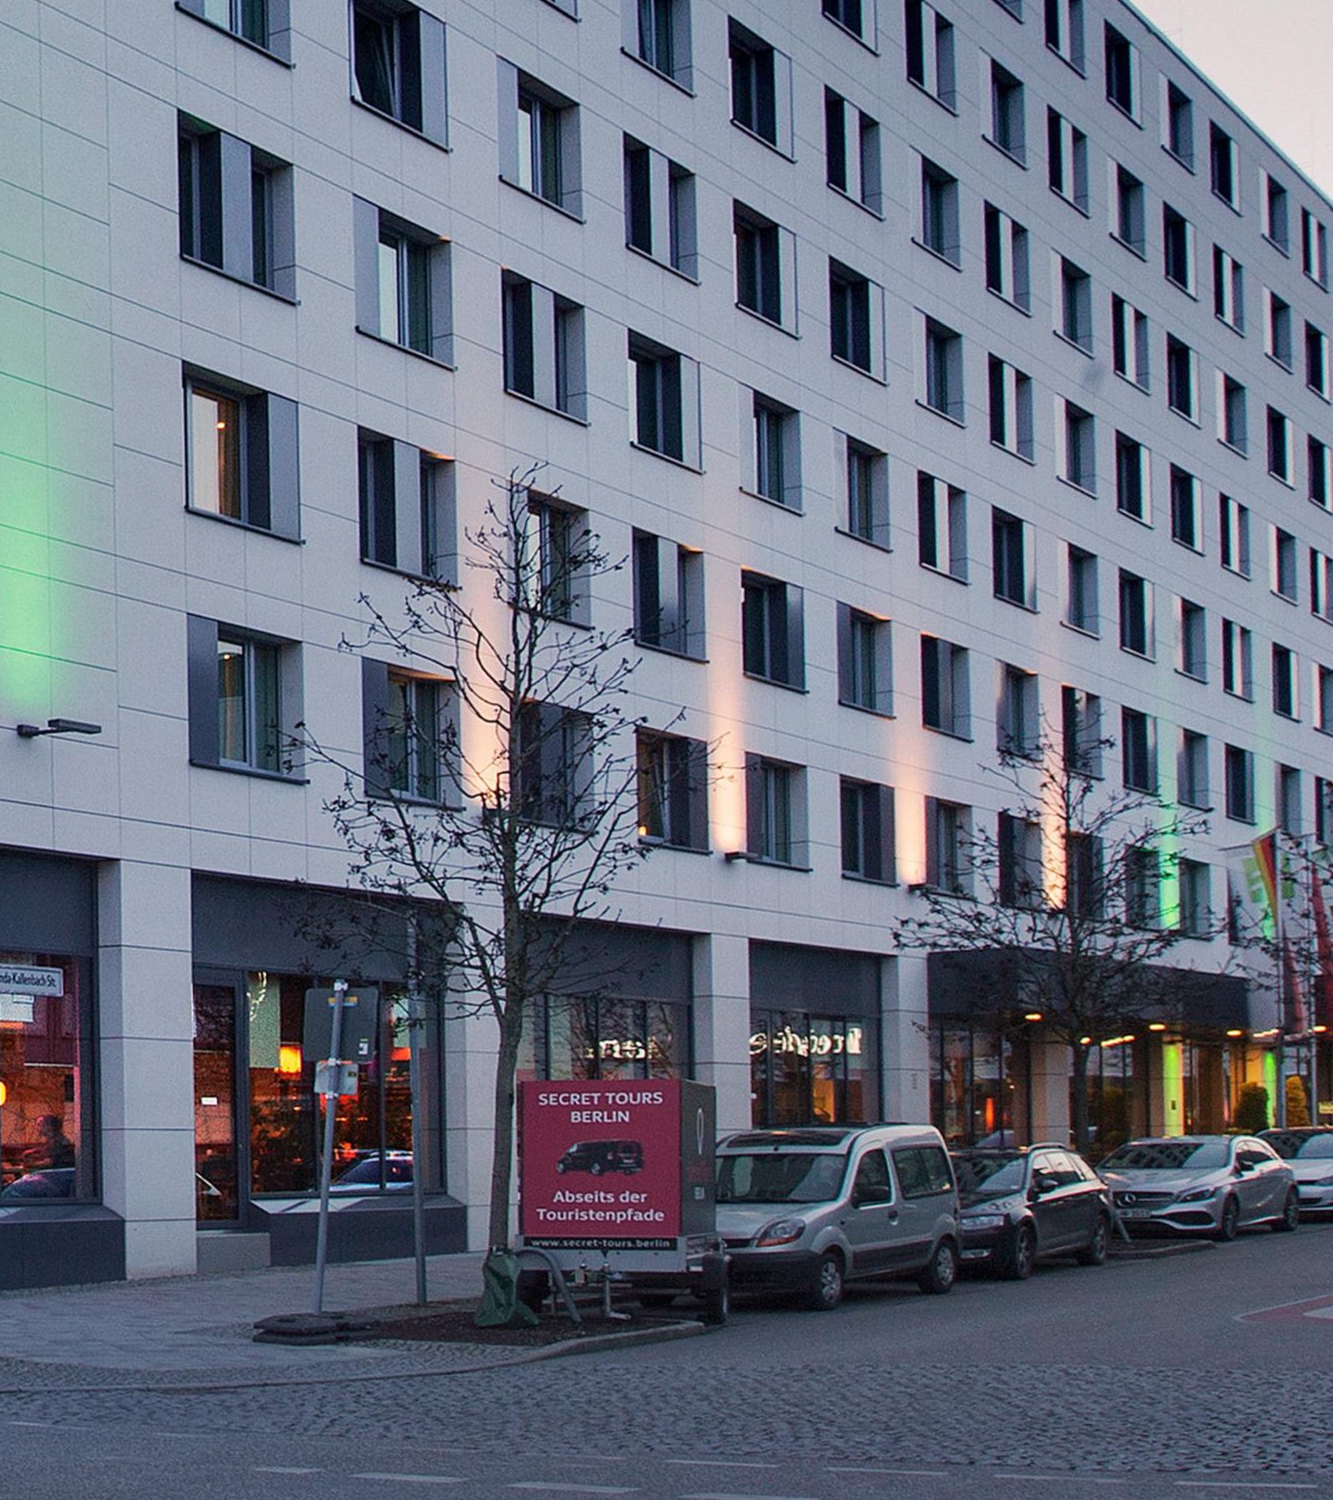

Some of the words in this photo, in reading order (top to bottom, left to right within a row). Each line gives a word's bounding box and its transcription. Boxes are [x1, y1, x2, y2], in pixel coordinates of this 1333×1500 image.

[538, 1093, 601, 1106] SECRET
[605, 1092, 663, 1105] TOURS
[570, 1111, 630, 1123] BERLIN
[553, 1191, 615, 1203] Abseits
[619, 1191, 647, 1203] der
[536, 1208, 665, 1223] Touristenpfade
[531, 1238, 671, 1248] www.secret-tours.berlin
